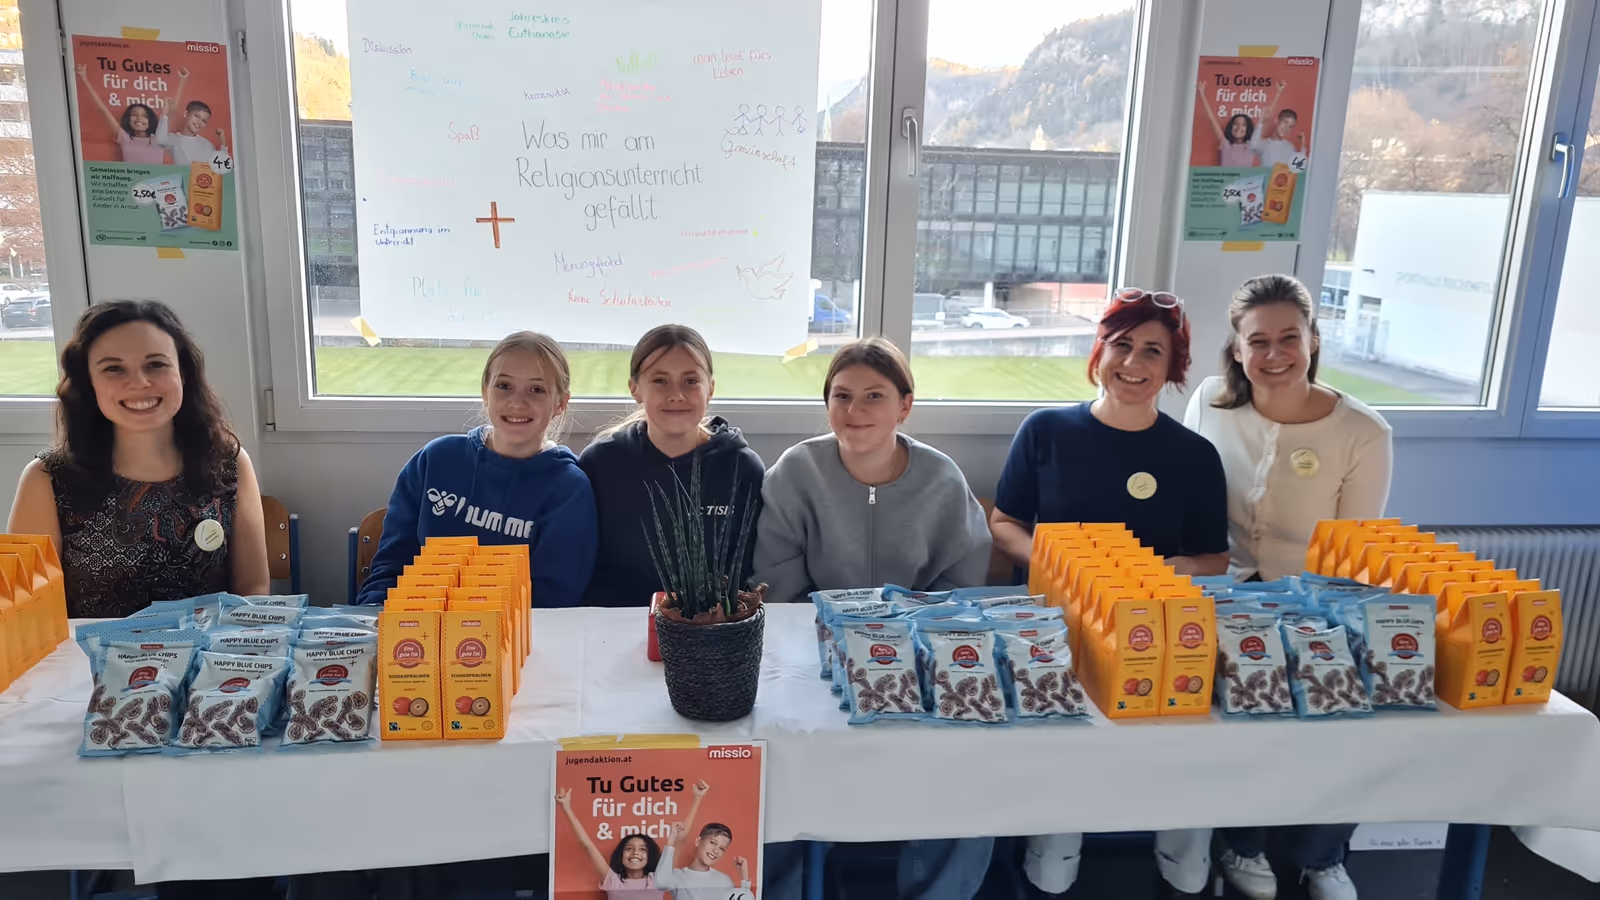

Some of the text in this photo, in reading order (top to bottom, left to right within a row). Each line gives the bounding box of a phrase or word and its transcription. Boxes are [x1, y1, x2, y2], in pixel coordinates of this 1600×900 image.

[508, 27, 570, 40] Euthanasie
[187, 43, 219, 53] missio
[361, 37, 413, 55] Diskussion
[96, 57, 171, 74] Tu Gutes
[713, 66, 744, 80] Leben
[103, 73, 168, 92] für dich
[1214, 73, 1272, 87] Tu Gutes
[109, 92, 164, 109] & mich
[1216, 88, 1267, 103] für dich
[1217, 105, 1261, 118] & mich
[447, 121, 480, 144] Spaß
[521, 119, 655, 151] Was mir am
[721, 128, 797, 169] Gemeinschaft
[89, 166, 125, 174] Gemeinsam
[516, 156, 704, 200] Religionsunterricht
[584, 193, 659, 231] gefällt
[268, 614, 286, 622] CHIPS
[328, 649, 345, 657] BLUE
[236, 661, 253, 669] BLUE
[253, 662, 273, 670] CHIPS
[564, 755, 633, 766] jugendaktion.at
[708, 747, 752, 759] missio
[586, 775, 685, 794] Tu Gutes
[592, 796, 678, 817] für dich
[596, 819, 671, 840] & mich
